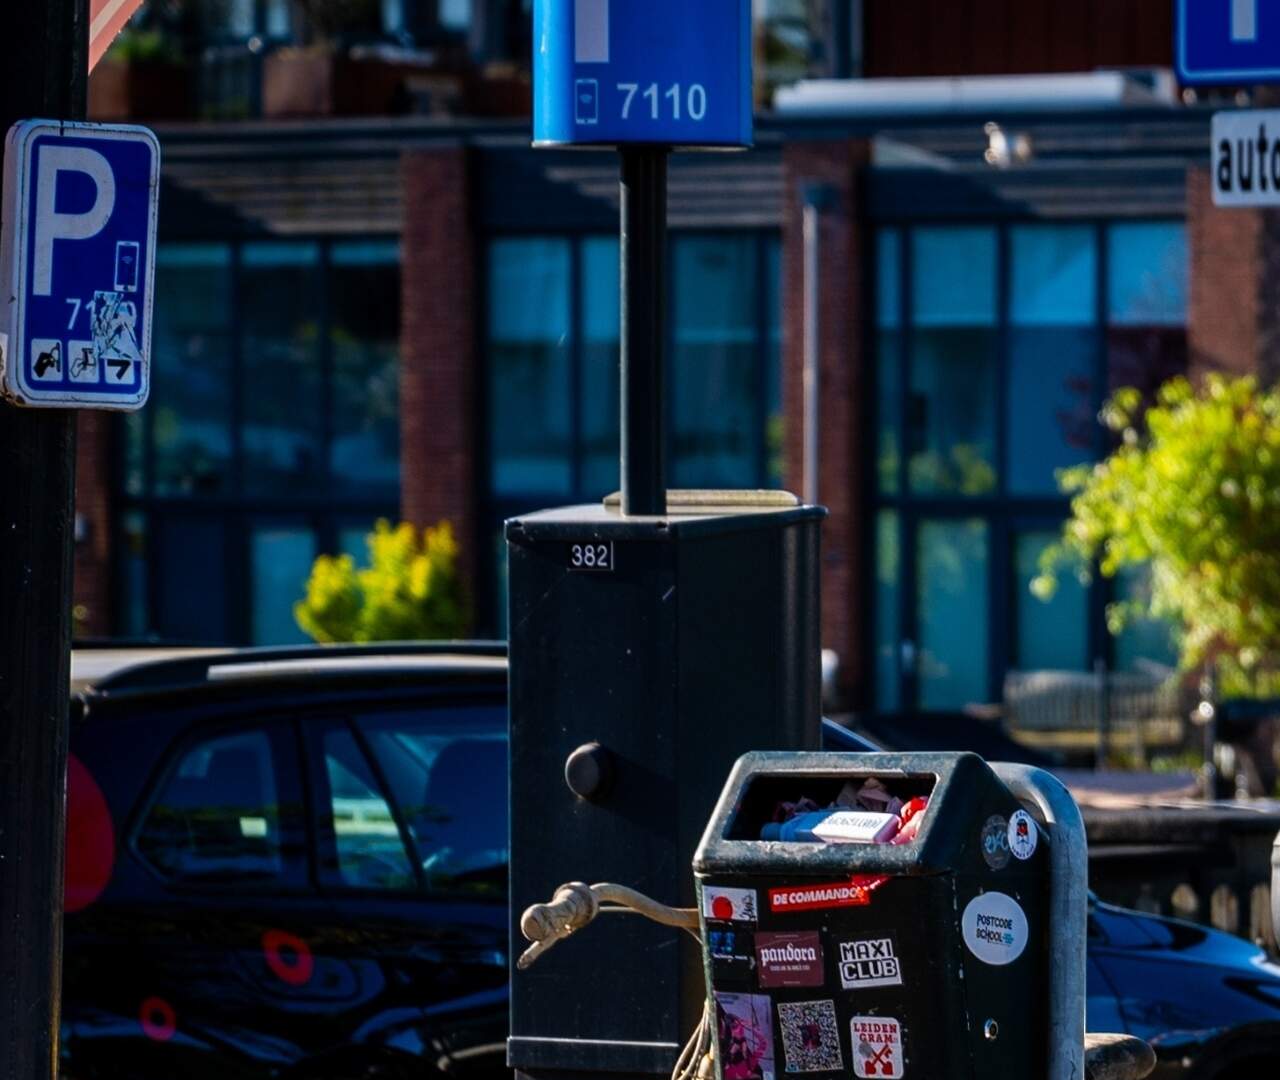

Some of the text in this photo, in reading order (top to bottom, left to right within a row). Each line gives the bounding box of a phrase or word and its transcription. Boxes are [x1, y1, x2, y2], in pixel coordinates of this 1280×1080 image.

[616, 82, 707, 121] 7110
[33, 144, 116, 297] P
[571, 544, 608, 567] 382
[772, 893, 789, 906] DE
[976, 913, 1013, 930] POSTCODE
[975, 926, 1003, 944] SCHOOL
[760, 941, 817, 967] pandora
[842, 938, 891, 961] MAXI
[842, 959, 898, 980] CLUB
[853, 1022, 897, 1034] LEIDEN
